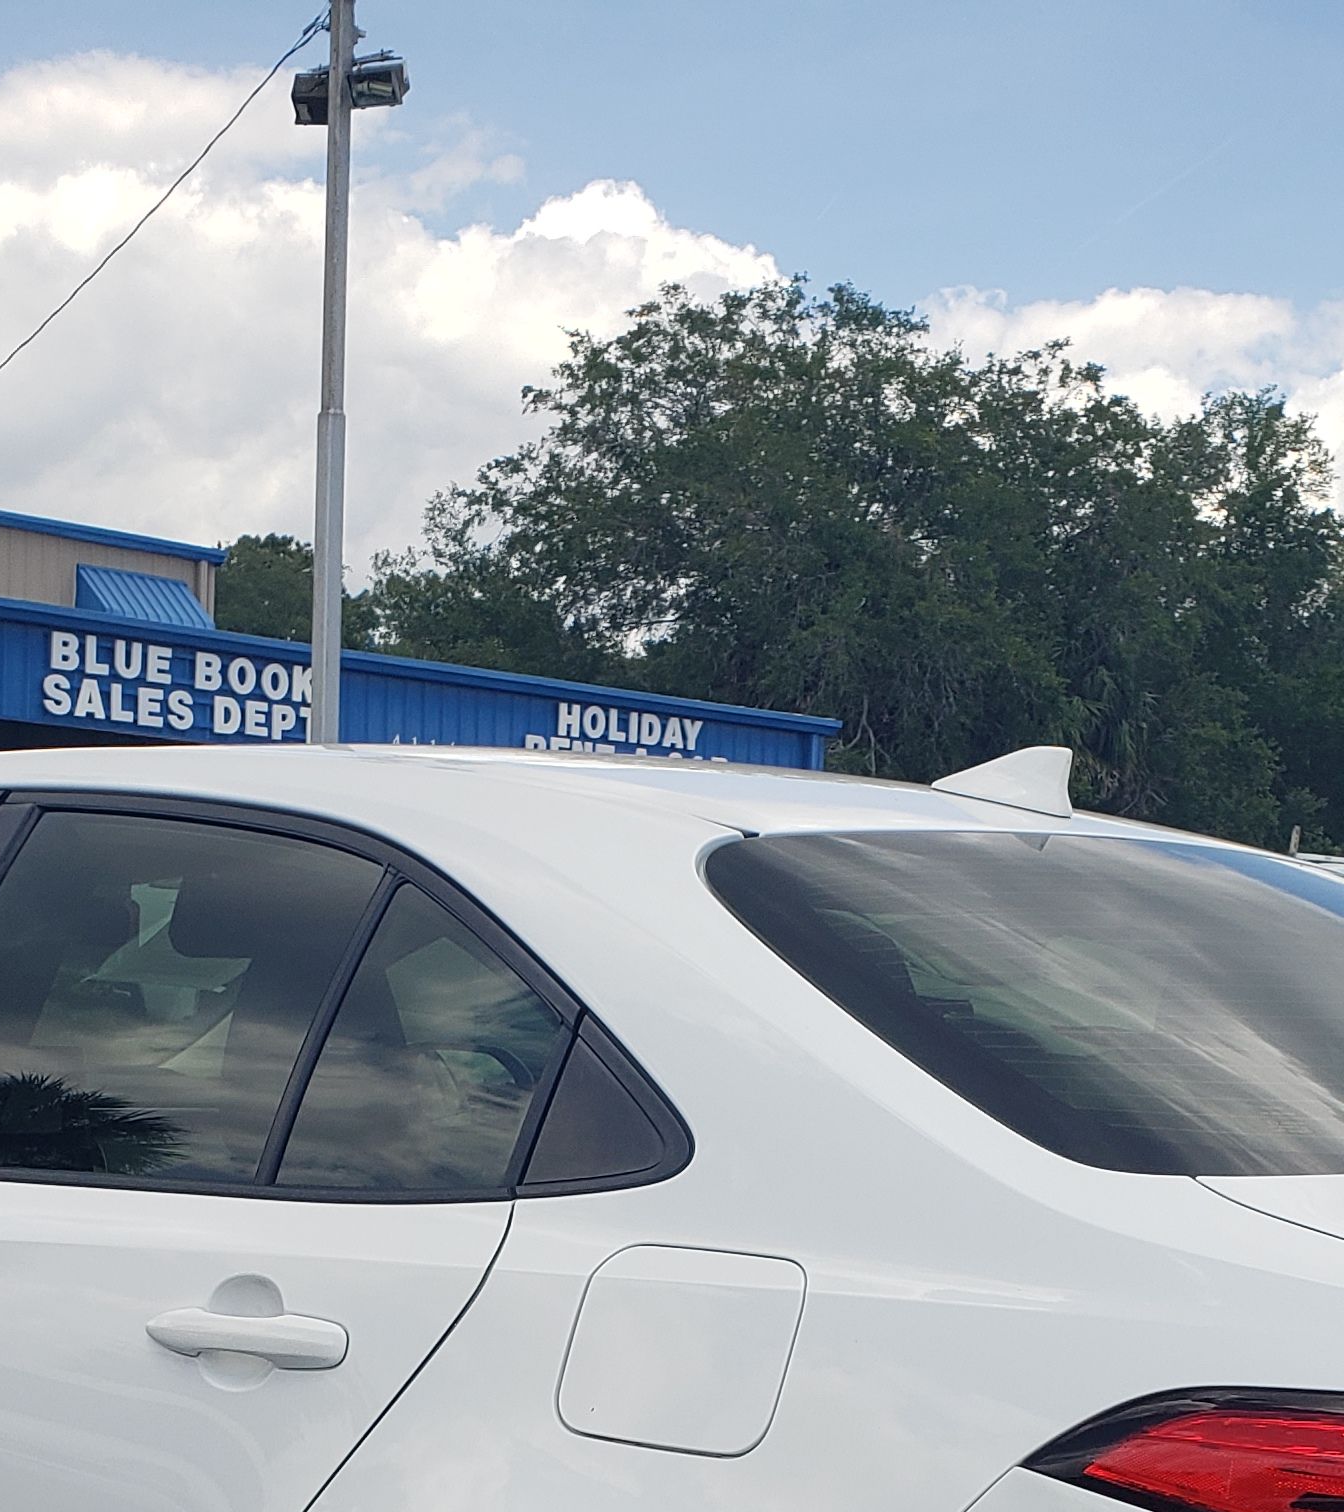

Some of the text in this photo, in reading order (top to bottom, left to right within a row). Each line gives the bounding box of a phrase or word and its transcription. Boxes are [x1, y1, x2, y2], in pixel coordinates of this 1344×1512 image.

[50, 631, 313, 704] BLUE BOOK
[43, 674, 194, 730] SALES
[557, 702, 704, 751] HOLIDAY
